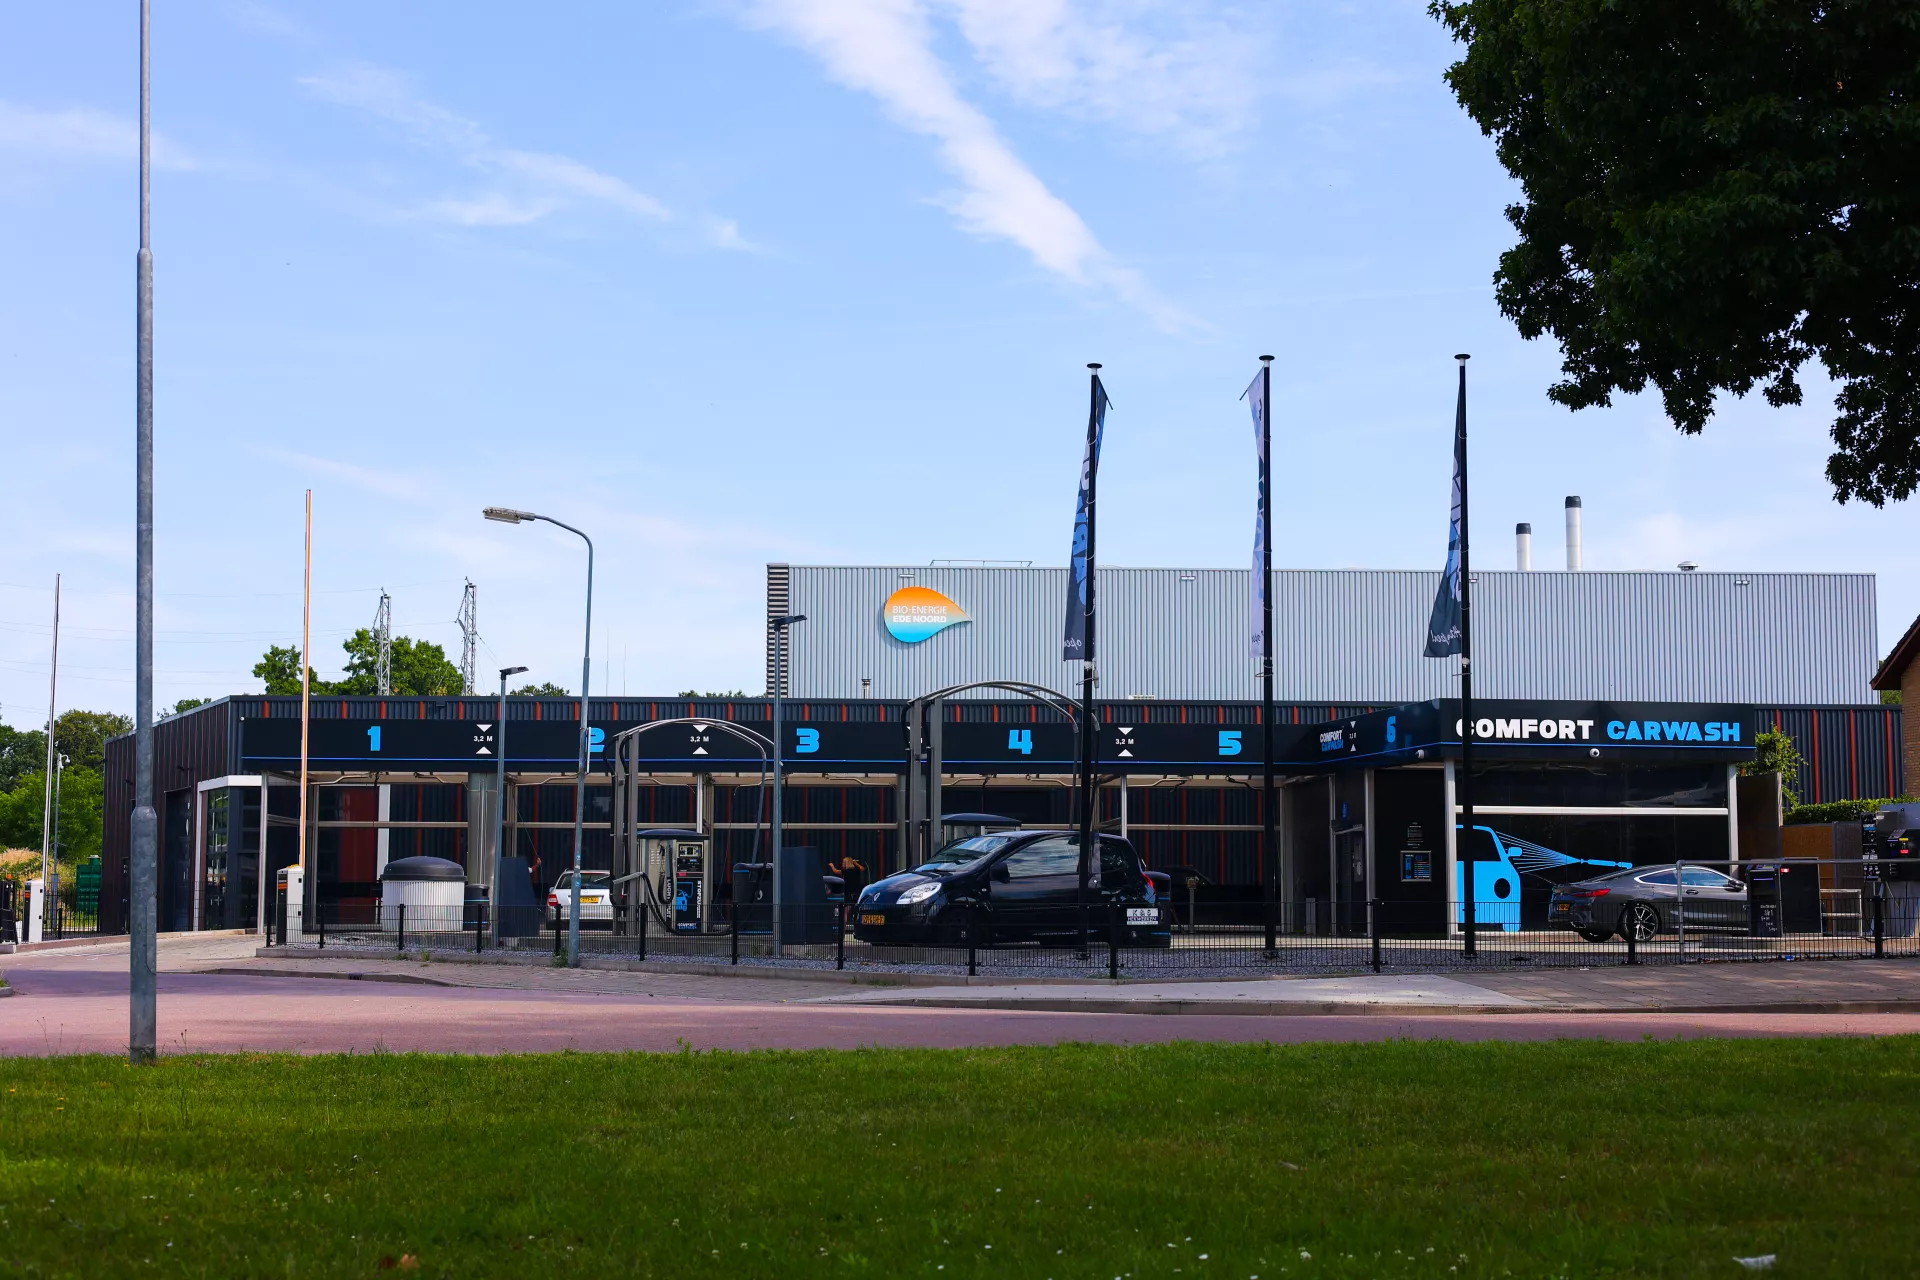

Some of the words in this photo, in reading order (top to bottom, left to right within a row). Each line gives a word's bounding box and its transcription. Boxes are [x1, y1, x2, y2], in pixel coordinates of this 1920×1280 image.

[892, 605, 948, 614] BIO-ENERGIE
[892, 615, 912, 623] EDE
[913, 615, 947, 623] NOORD
[367, 726, 381, 751] 1
[473, 735, 484, 743] 3,2
[585, 727, 605, 752] 2
[796, 728, 820, 753] 3
[1320, 729, 1343, 743] COMFORT
[1386, 715, 1397, 743] 6
[1455, 718, 1594, 740] COMFORT
[1606, 720, 1741, 742] CARWASH
[1008, 729, 1032, 754] 4
[1115, 738, 1126, 746] 3,2
[1218, 730, 1242, 756] 5
